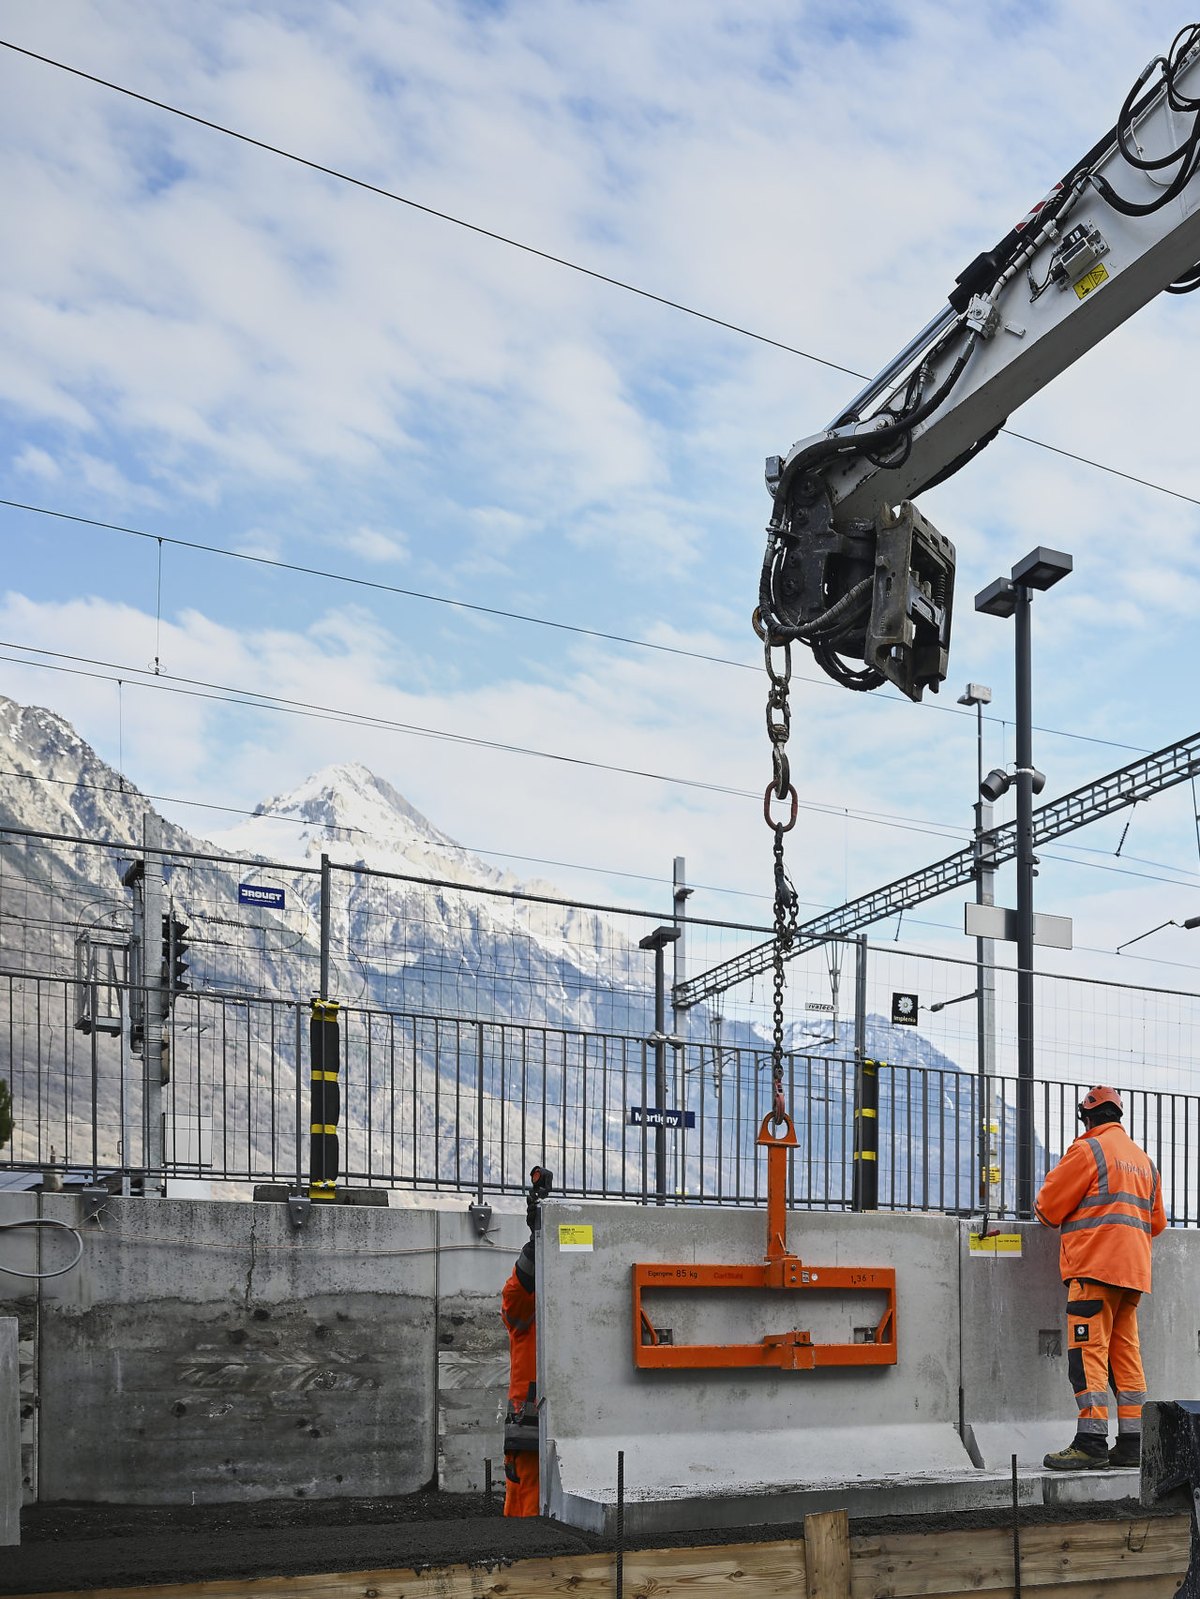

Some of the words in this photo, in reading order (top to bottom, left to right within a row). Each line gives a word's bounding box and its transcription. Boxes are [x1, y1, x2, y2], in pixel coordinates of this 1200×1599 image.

[893, 1014, 917, 1023] Implenia
[676, 1269, 687, 1278] 85
[689, 1270, 698, 1279] kg
[869, 1274, 875, 1283] T
